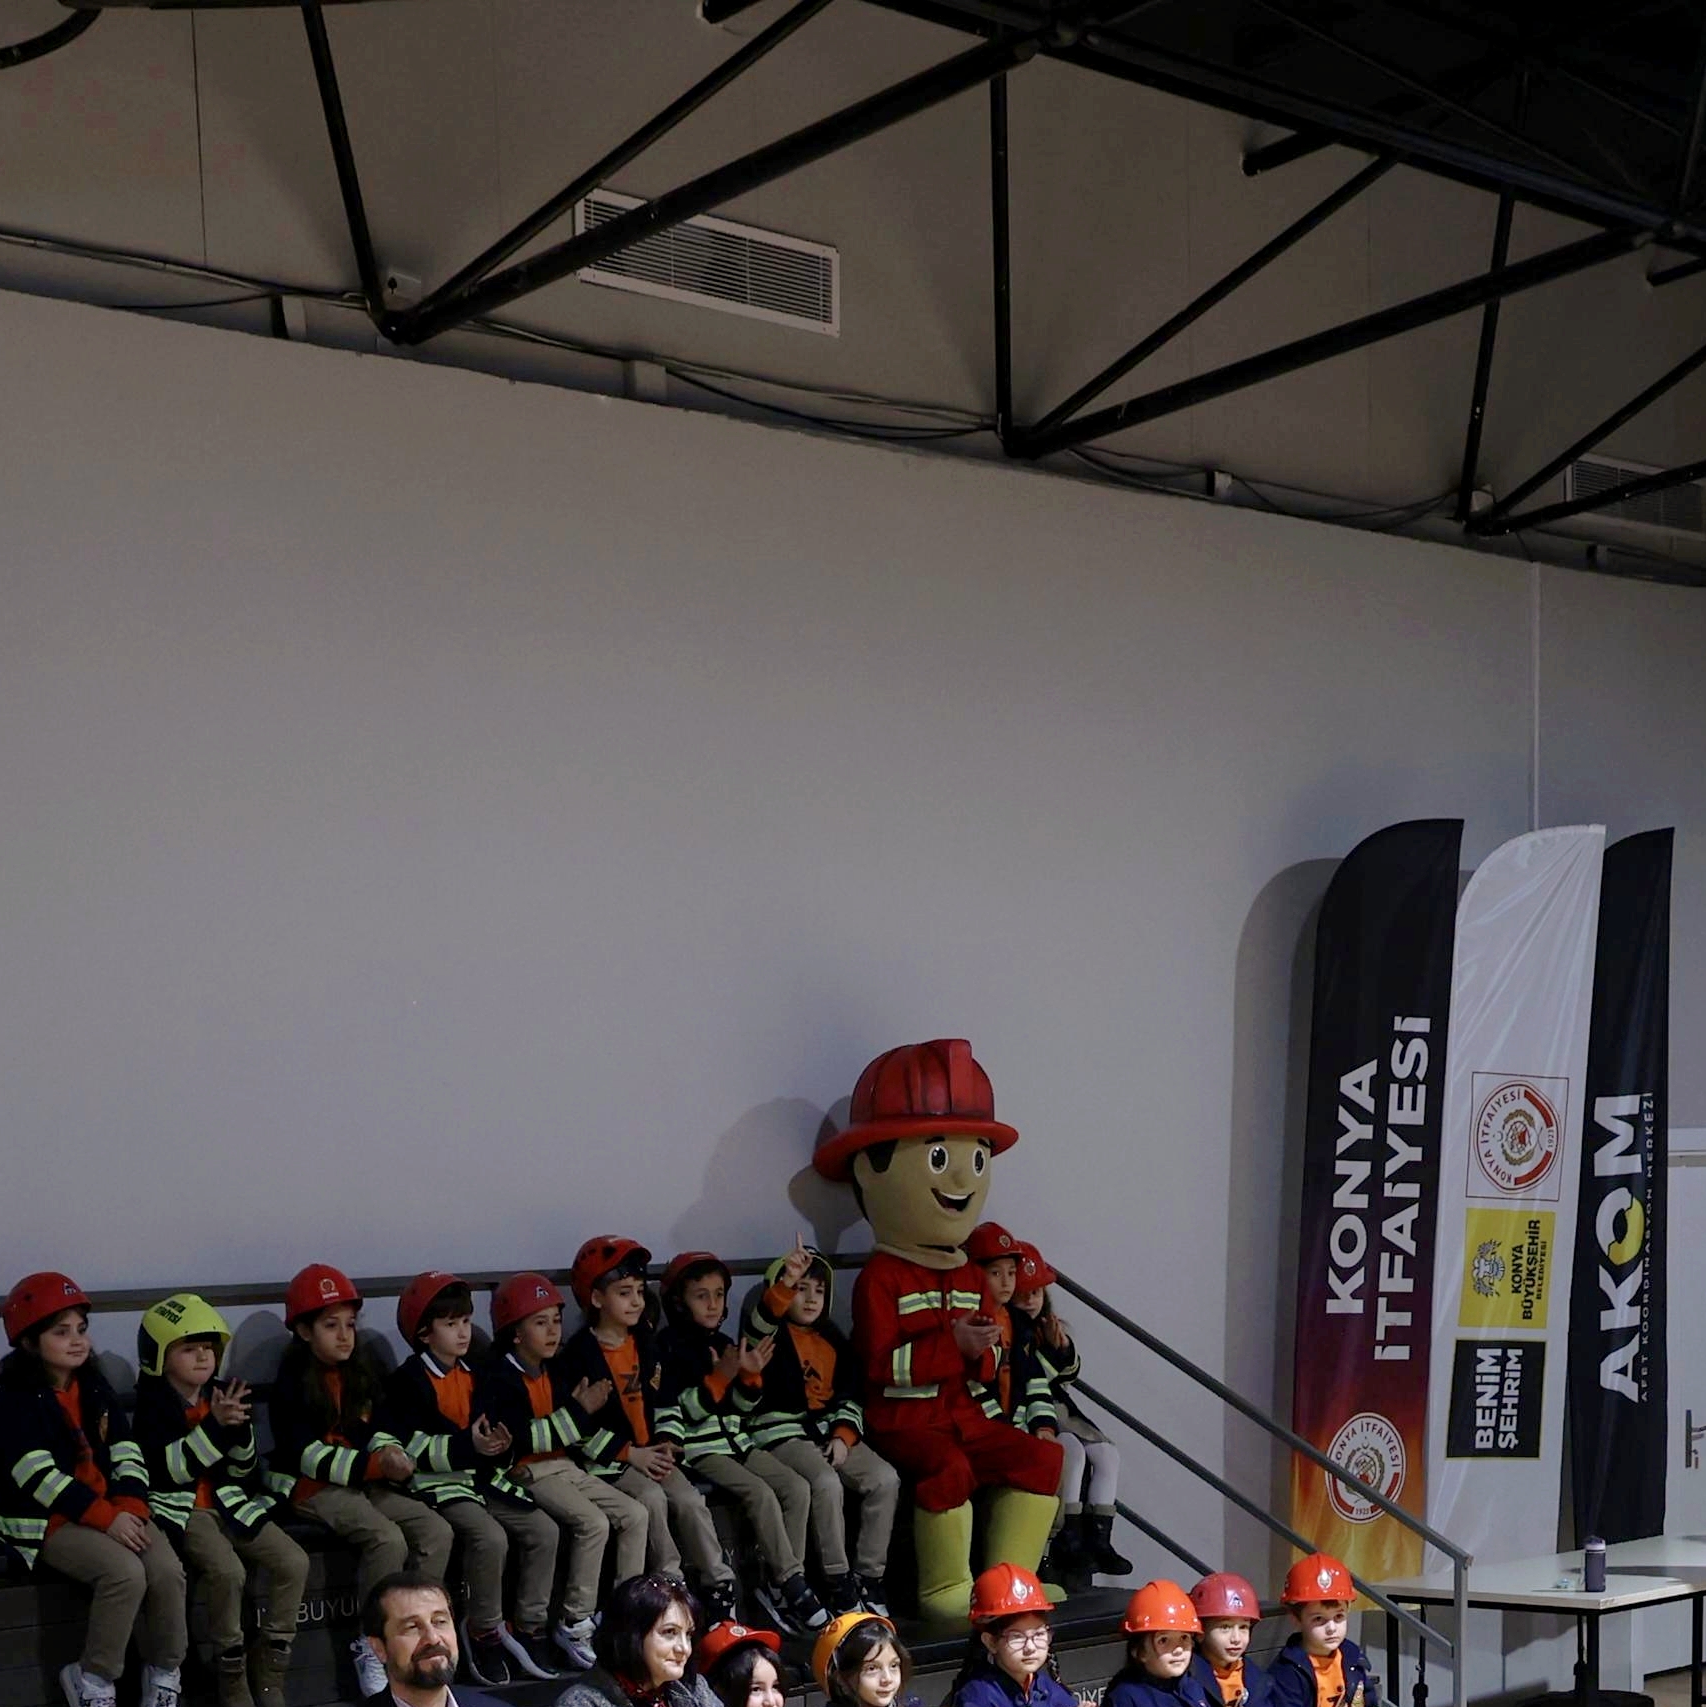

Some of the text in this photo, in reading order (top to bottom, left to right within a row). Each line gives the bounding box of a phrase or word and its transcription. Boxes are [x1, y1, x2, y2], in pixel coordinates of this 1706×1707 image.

[1326, 1059, 1378, 1314] KONYA
[1374, 1015, 1431, 1361] İTFAİYESİ
[1483, 1149, 1512, 1185] KONYA
[1511, 1244, 1524, 1294] KONYA
[1521, 1219, 1541, 1320] BÜYÜKŞEHİR
[1594, 1094, 1644, 1403] AKOM
[1335, 1427, 1357, 1463] ONYA
[1475, 1348, 1502, 1449] BENİM
[1498, 1348, 1523, 1449] ŞEHRİM
